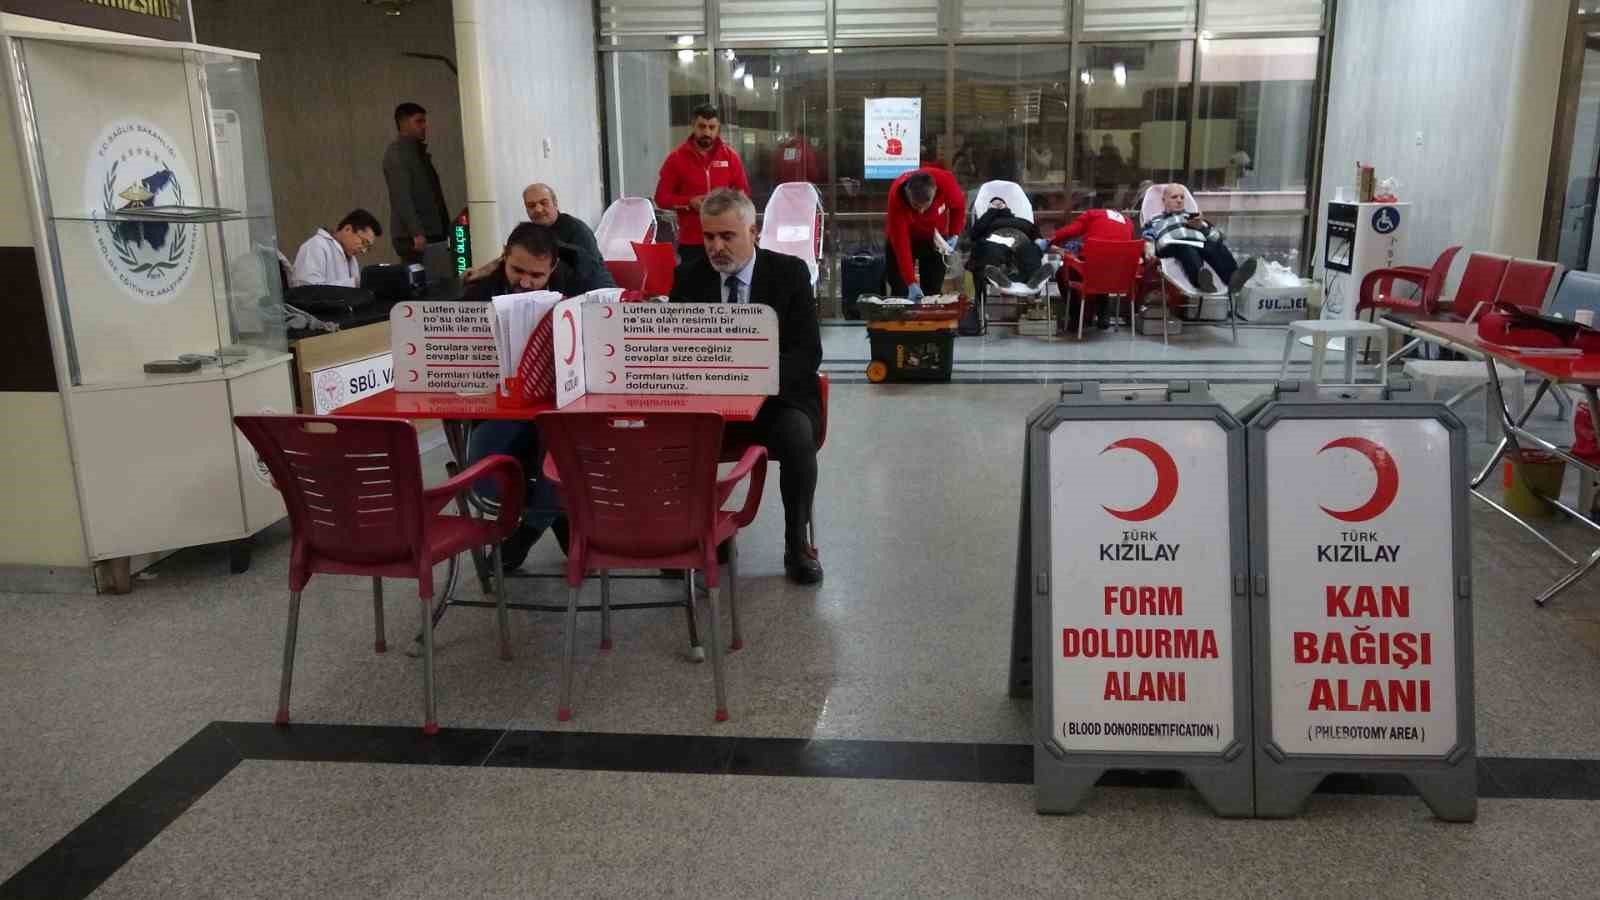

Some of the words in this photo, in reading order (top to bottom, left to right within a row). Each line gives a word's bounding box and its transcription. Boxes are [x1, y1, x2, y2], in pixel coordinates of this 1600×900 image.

[422, 305, 456, 314] Lütfen
[623, 306, 657, 315] Lütfen
[660, 306, 705, 315] üzerinde
[709, 306, 728, 315] T.C.
[731, 306, 763, 315] kimlik
[454, 315, 477, 323] olan
[656, 316, 679, 324] olan
[682, 316, 717, 324] resimli
[720, 316, 735, 324] bir
[424, 325, 454, 333] kimlik
[623, 326, 655, 334] kimlik
[658, 326, 671, 334] ile
[673, 326, 723, 334] müracaat
[425, 343, 469, 351] Sorulara
[624, 344, 669, 353] Sorulara
[672, 344, 733, 354] vereceğiniz
[425, 352, 469, 362] cevaplar
[472, 353, 493, 361] size
[624, 354, 669, 363] cevaplar
[672, 354, 693, 362] size
[349, 369, 381, 394] SBÜ.
[625, 372, 669, 381] Formları
[672, 372, 703, 381] lütfen
[705, 372, 750, 382] kendiniz
[625, 382, 688, 390] doldurunuz.
[1122, 529, 1159, 542] TÜRK
[1341, 530, 1378, 542] TÜRK
[1099, 543, 1181, 562] KIZILAY
[1317, 544, 1400, 563] KIZILAY
[1104, 586, 1184, 616] FORM
[1326, 585, 1410, 618] KAN
[1062, 628, 1219, 659] DOLDURMA
[1293, 624, 1432, 670] BAĞIŞI
[1103, 671, 1187, 702] ALANI
[1308, 678, 1431, 713] ALANI
